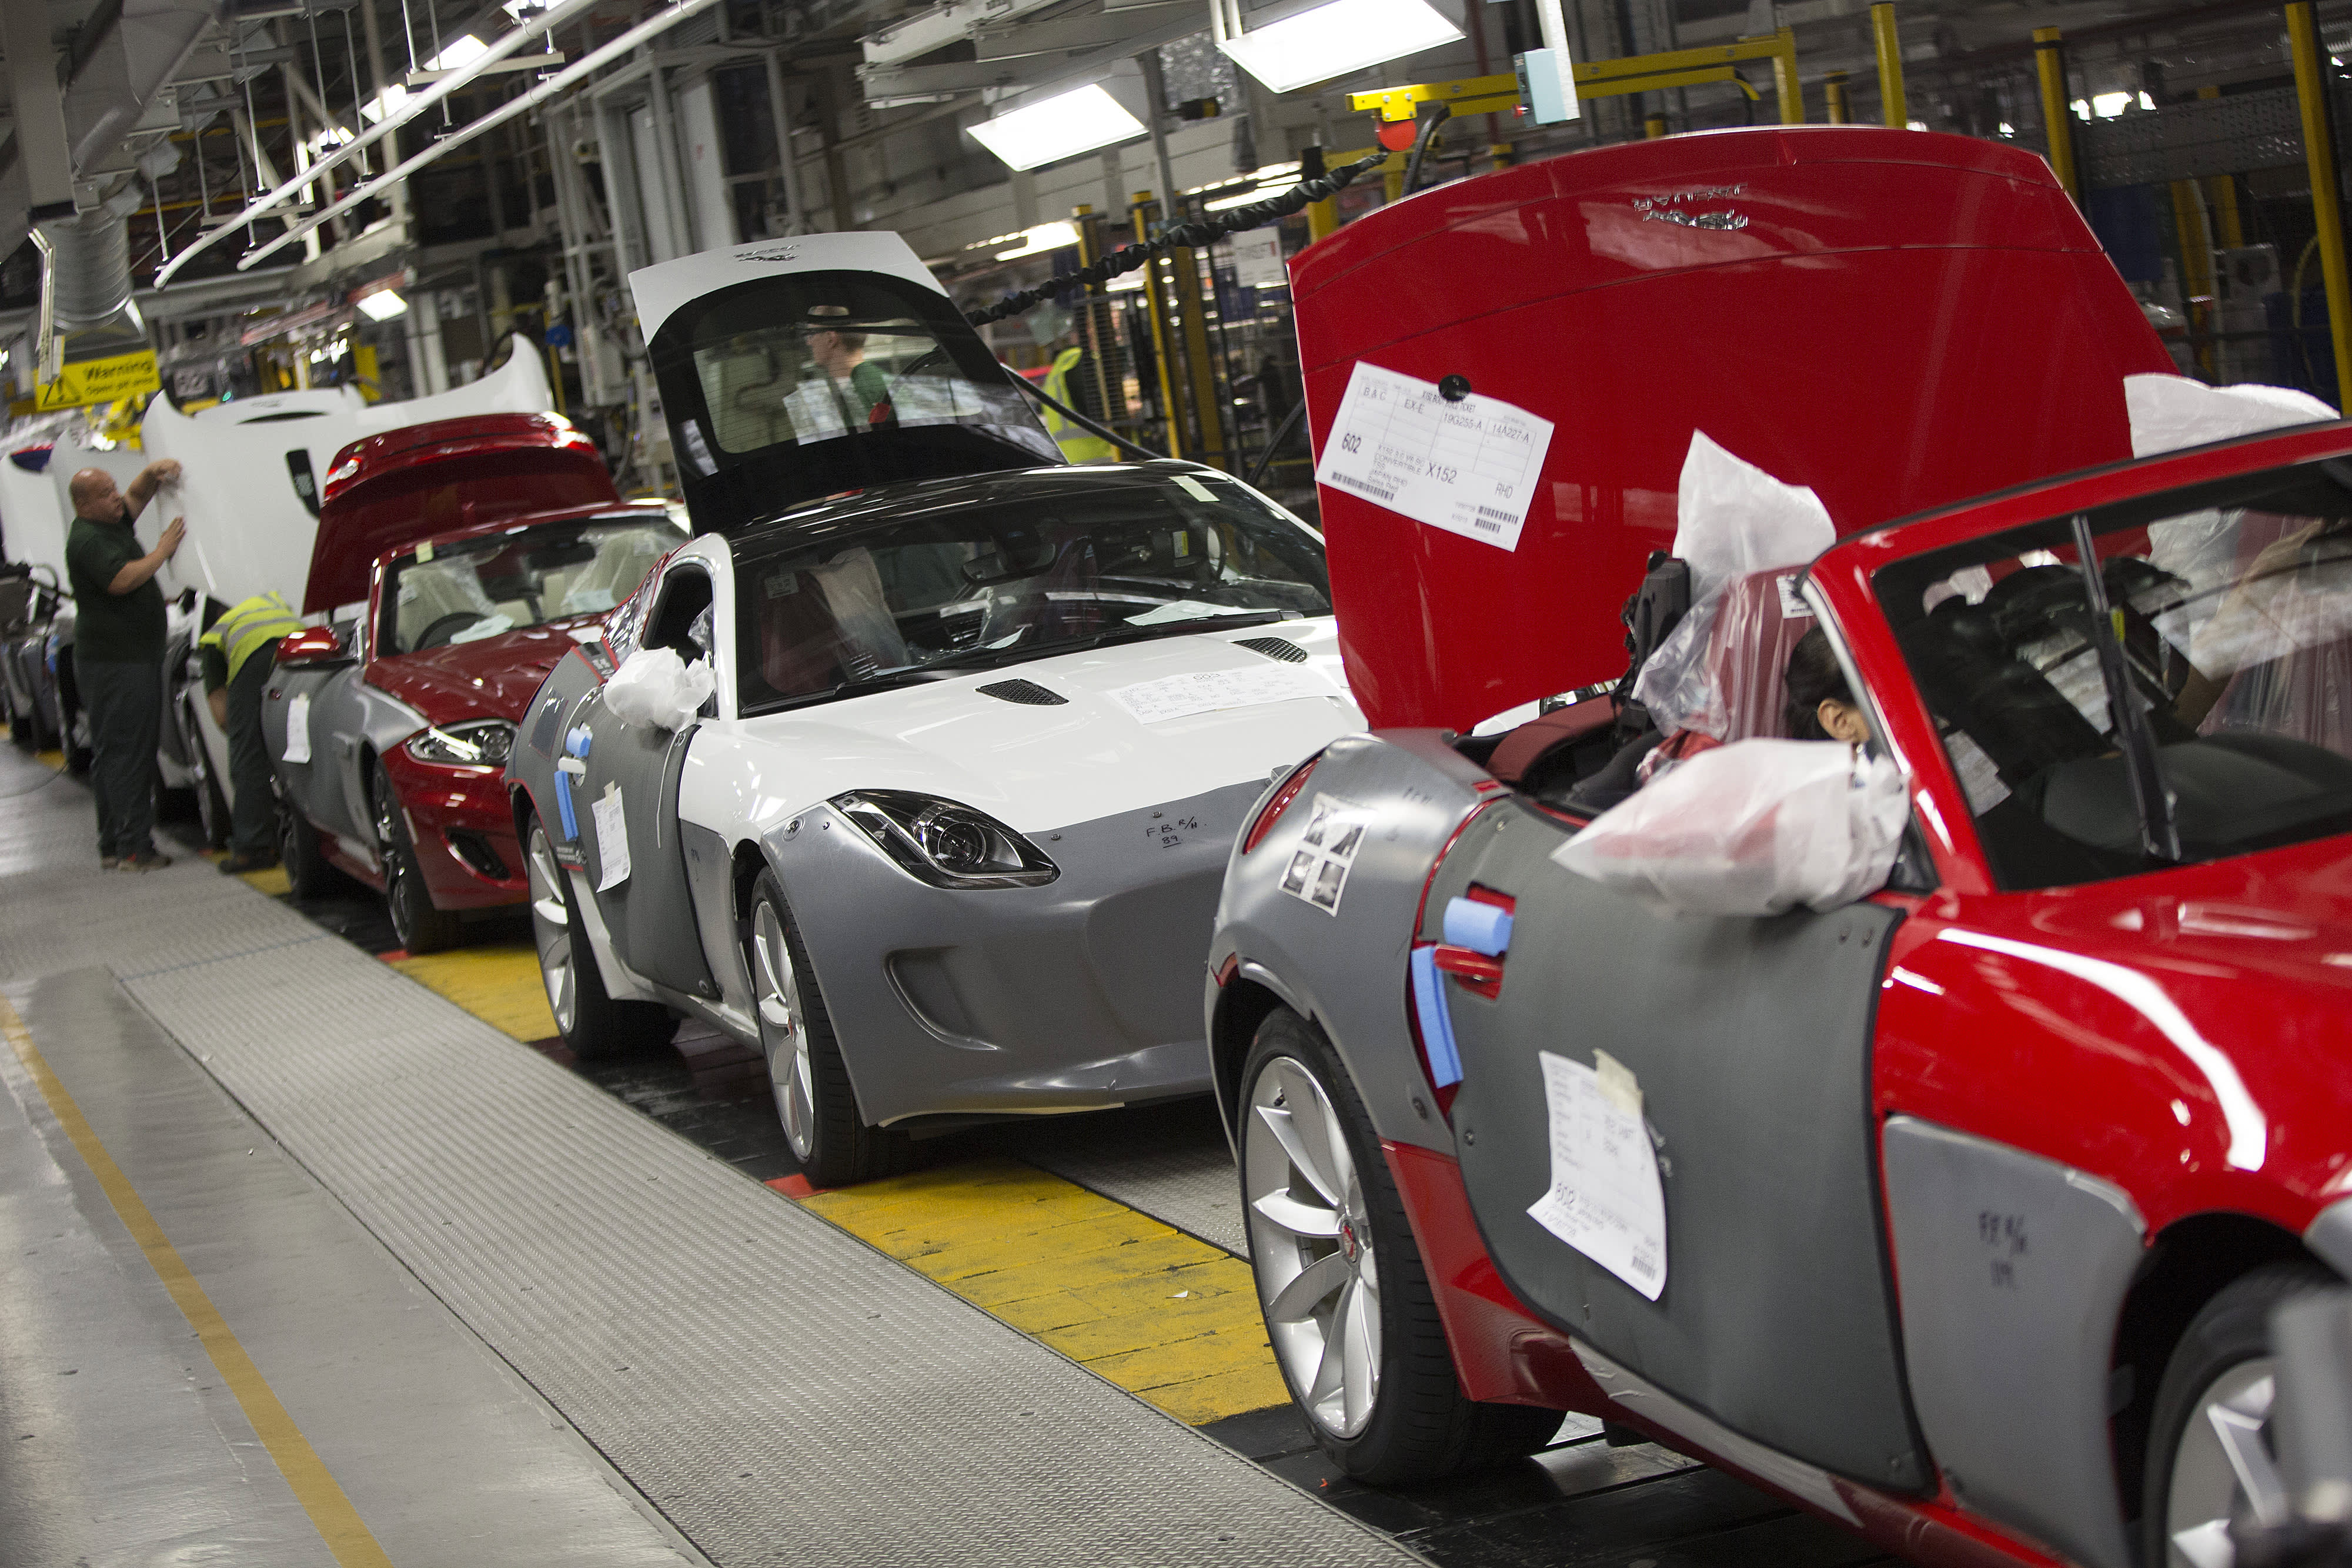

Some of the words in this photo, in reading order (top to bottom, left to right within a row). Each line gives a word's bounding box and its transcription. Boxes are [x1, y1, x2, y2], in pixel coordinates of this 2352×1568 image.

[83, 360, 154, 381] Warning
[1363, 387, 1370, 396] B
[1380, 392, 1387, 401] C
[1341, 433, 1361, 454] 602
[1374, 453, 1422, 476] CONVERTIBLE
[1425, 462, 1458, 484] X152
[1495, 482, 1514, 499] RHD
